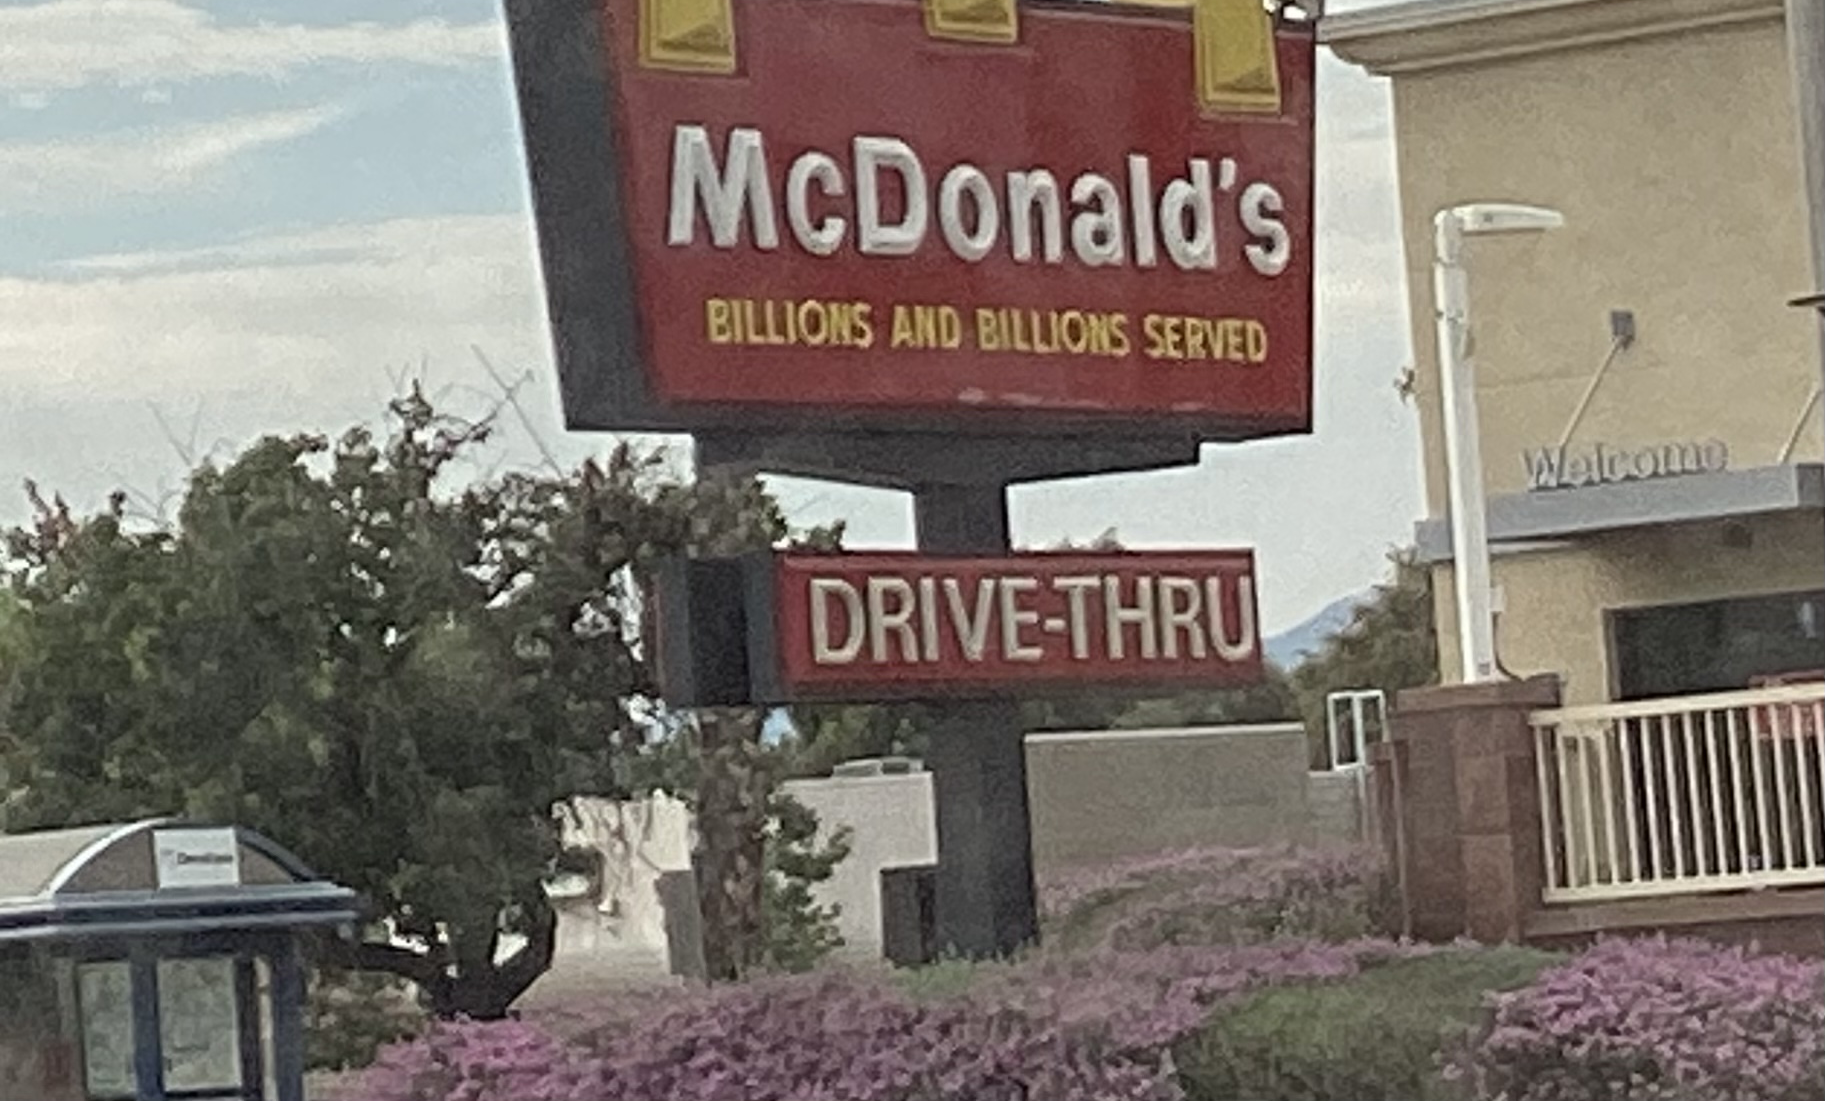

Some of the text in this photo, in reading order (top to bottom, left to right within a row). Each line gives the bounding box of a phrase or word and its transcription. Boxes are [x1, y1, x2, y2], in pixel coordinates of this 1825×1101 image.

[669, 126, 1290, 275] McDonald's
[708, 299, 1268, 364] BILLIONS AND BILLIONS SERVED
[1523, 439, 1728, 489] Welcome
[810, 576, 1254, 664] DRIVE-THRU
